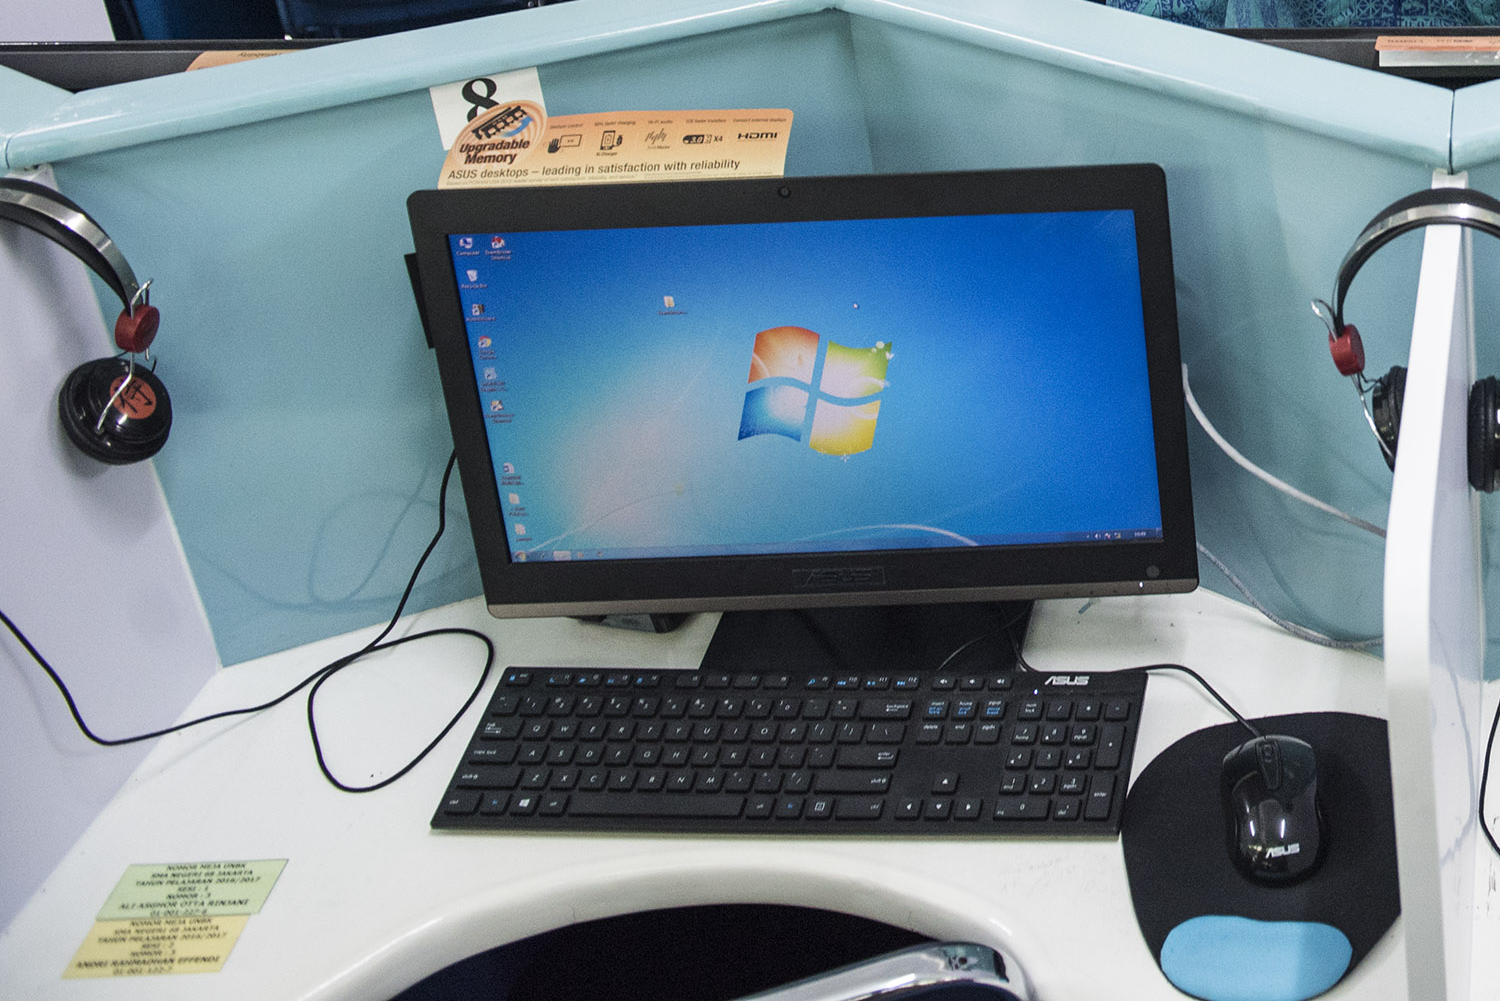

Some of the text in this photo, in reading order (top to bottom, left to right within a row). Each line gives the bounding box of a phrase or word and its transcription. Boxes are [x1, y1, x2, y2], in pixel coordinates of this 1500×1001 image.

[462, 78, 500, 122] 8
[738, 131, 778, 140] HDMI
[460, 138, 530, 155] Upgradable
[464, 153, 517, 165] Memory
[448, 169, 478, 180] ASUS
[480, 168, 528, 179] desktops
[542, 164, 581, 176] leading
[585, 164, 594, 174] in
[598, 161, 660, 174] satisfaction
[664, 161, 687, 172] with
[690, 159, 741, 172] reliability
[1044, 675, 1090, 686] ASUS
[1265, 843, 1300, 858] ASUS
